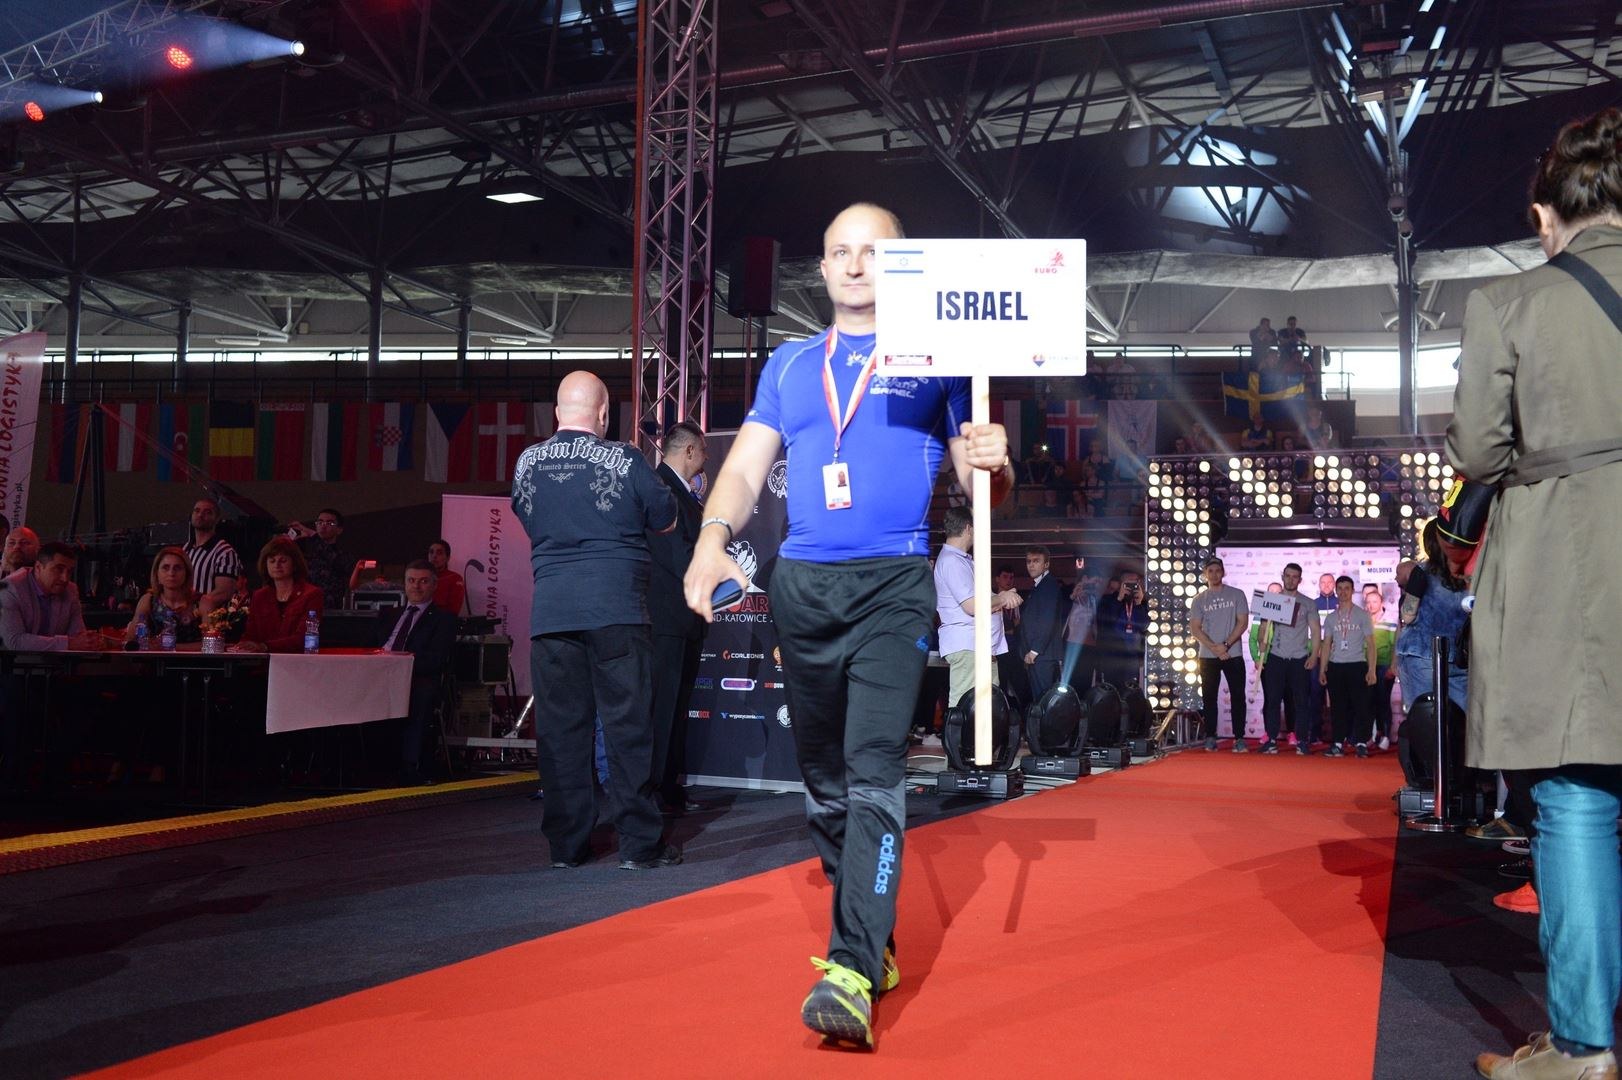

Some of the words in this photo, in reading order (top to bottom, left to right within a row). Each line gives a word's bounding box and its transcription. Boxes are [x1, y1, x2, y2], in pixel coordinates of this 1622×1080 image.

[936, 291, 1028, 321] ISRAEL
[538, 463, 561, 471] Limited
[563, 462, 587, 470] Series
[487, 508, 502, 583] LOGISTYKA
[486, 585, 498, 619] ONIA
[1203, 601, 1235, 612] LATVIJA
[1262, 600, 1282, 611] LATVIA
[874, 833, 896, 895] adidas
